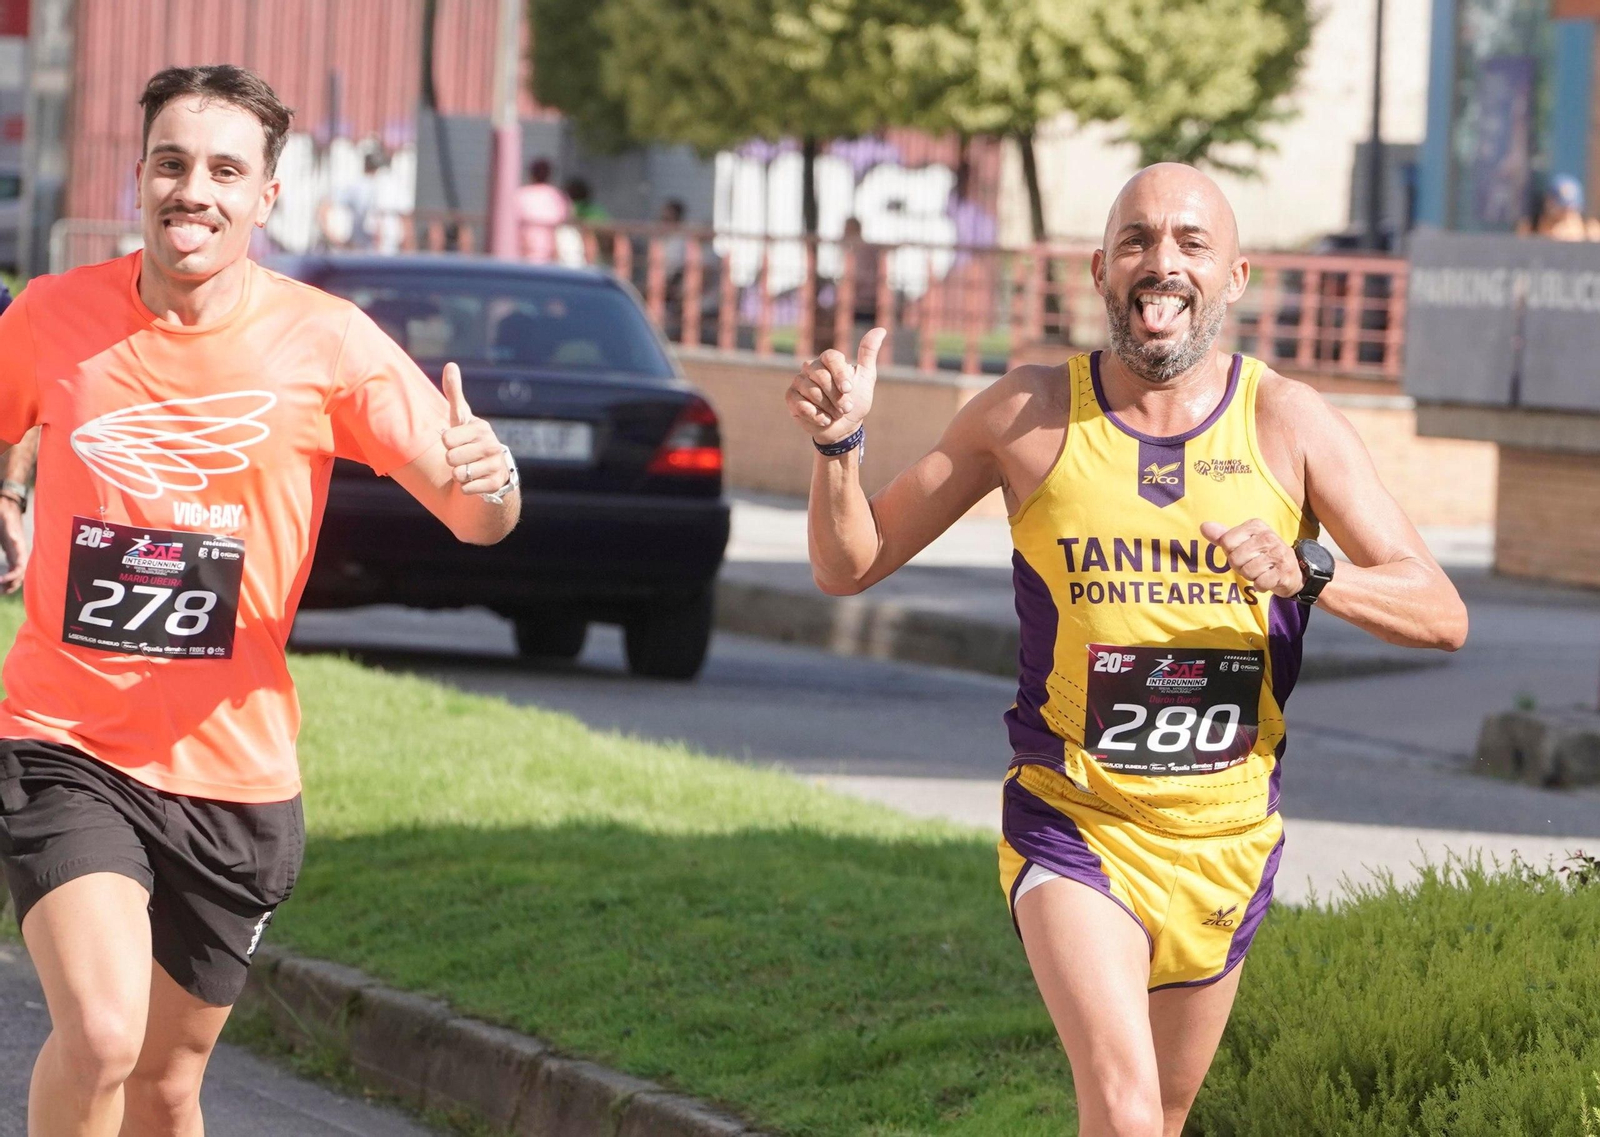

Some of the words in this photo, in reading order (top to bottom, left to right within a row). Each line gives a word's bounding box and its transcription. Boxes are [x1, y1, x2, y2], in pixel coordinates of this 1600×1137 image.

[1141, 475, 1179, 485] ZICO
[76, 526, 102, 546] 20
[140, 544, 182, 560] CAE
[1057, 537, 1232, 574] TANINO
[123, 557, 184, 570] INTERRUNNING
[118, 573, 149, 584] MARIO
[149, 576, 183, 587] UBEIRA
[1069, 581, 1259, 606] PONTEAREAS
[78, 580, 217, 635] 278
[1094, 652, 1122, 673] 20
[1122, 654, 1136, 662] SEP
[1163, 663, 1205, 678] CAE
[1148, 678, 1206, 686] INTERRUNNING
[1097, 704, 1240, 753] 280
